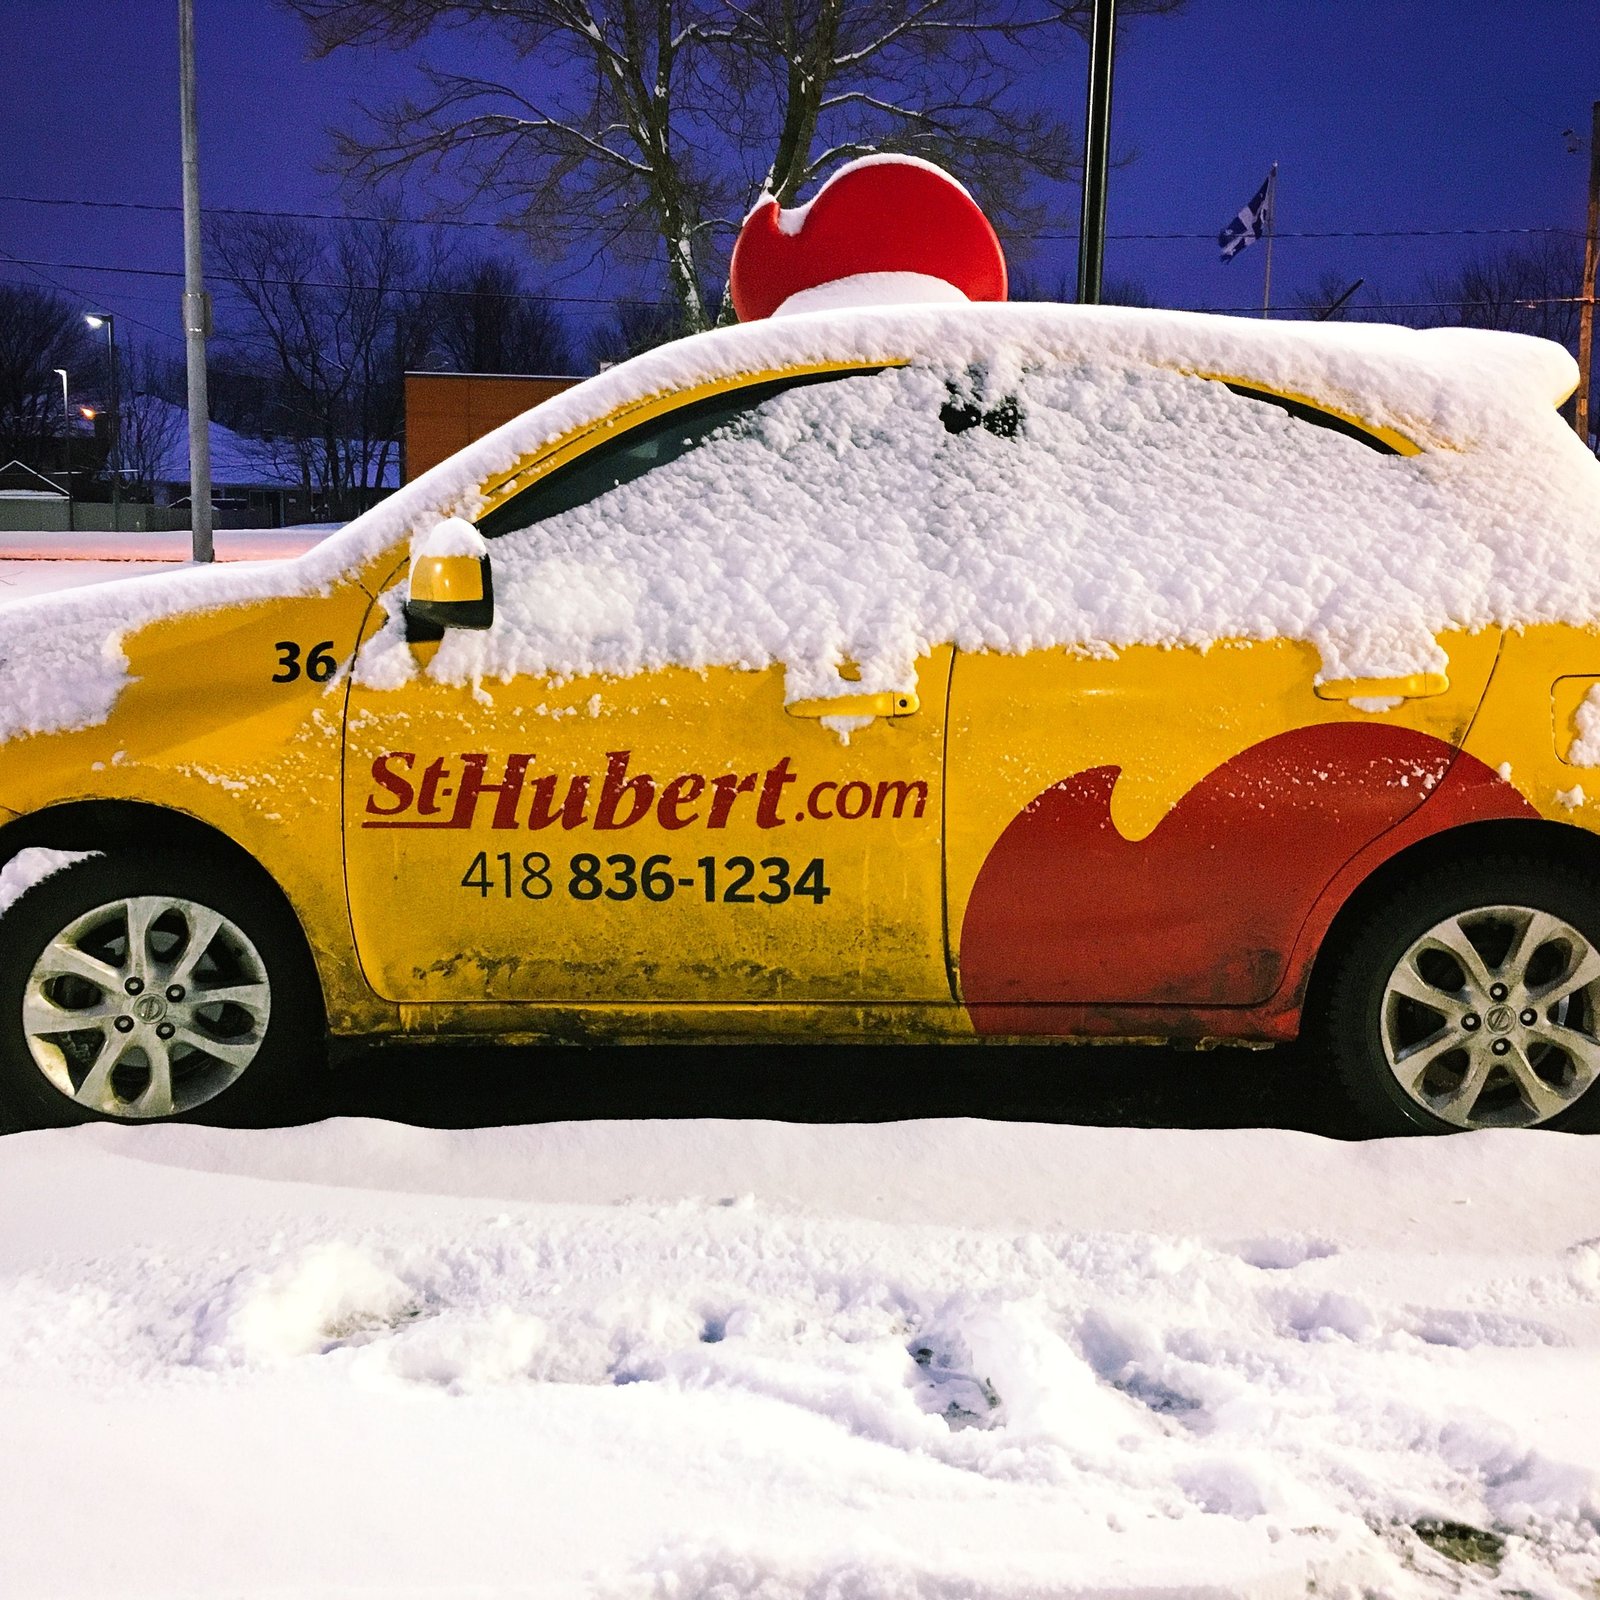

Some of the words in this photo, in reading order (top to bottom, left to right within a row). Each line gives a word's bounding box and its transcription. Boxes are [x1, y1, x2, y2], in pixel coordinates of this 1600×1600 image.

[272, 641, 337, 682] 36
[462, 851, 553, 898] 418
[568, 853, 831, 904] 836-1234
